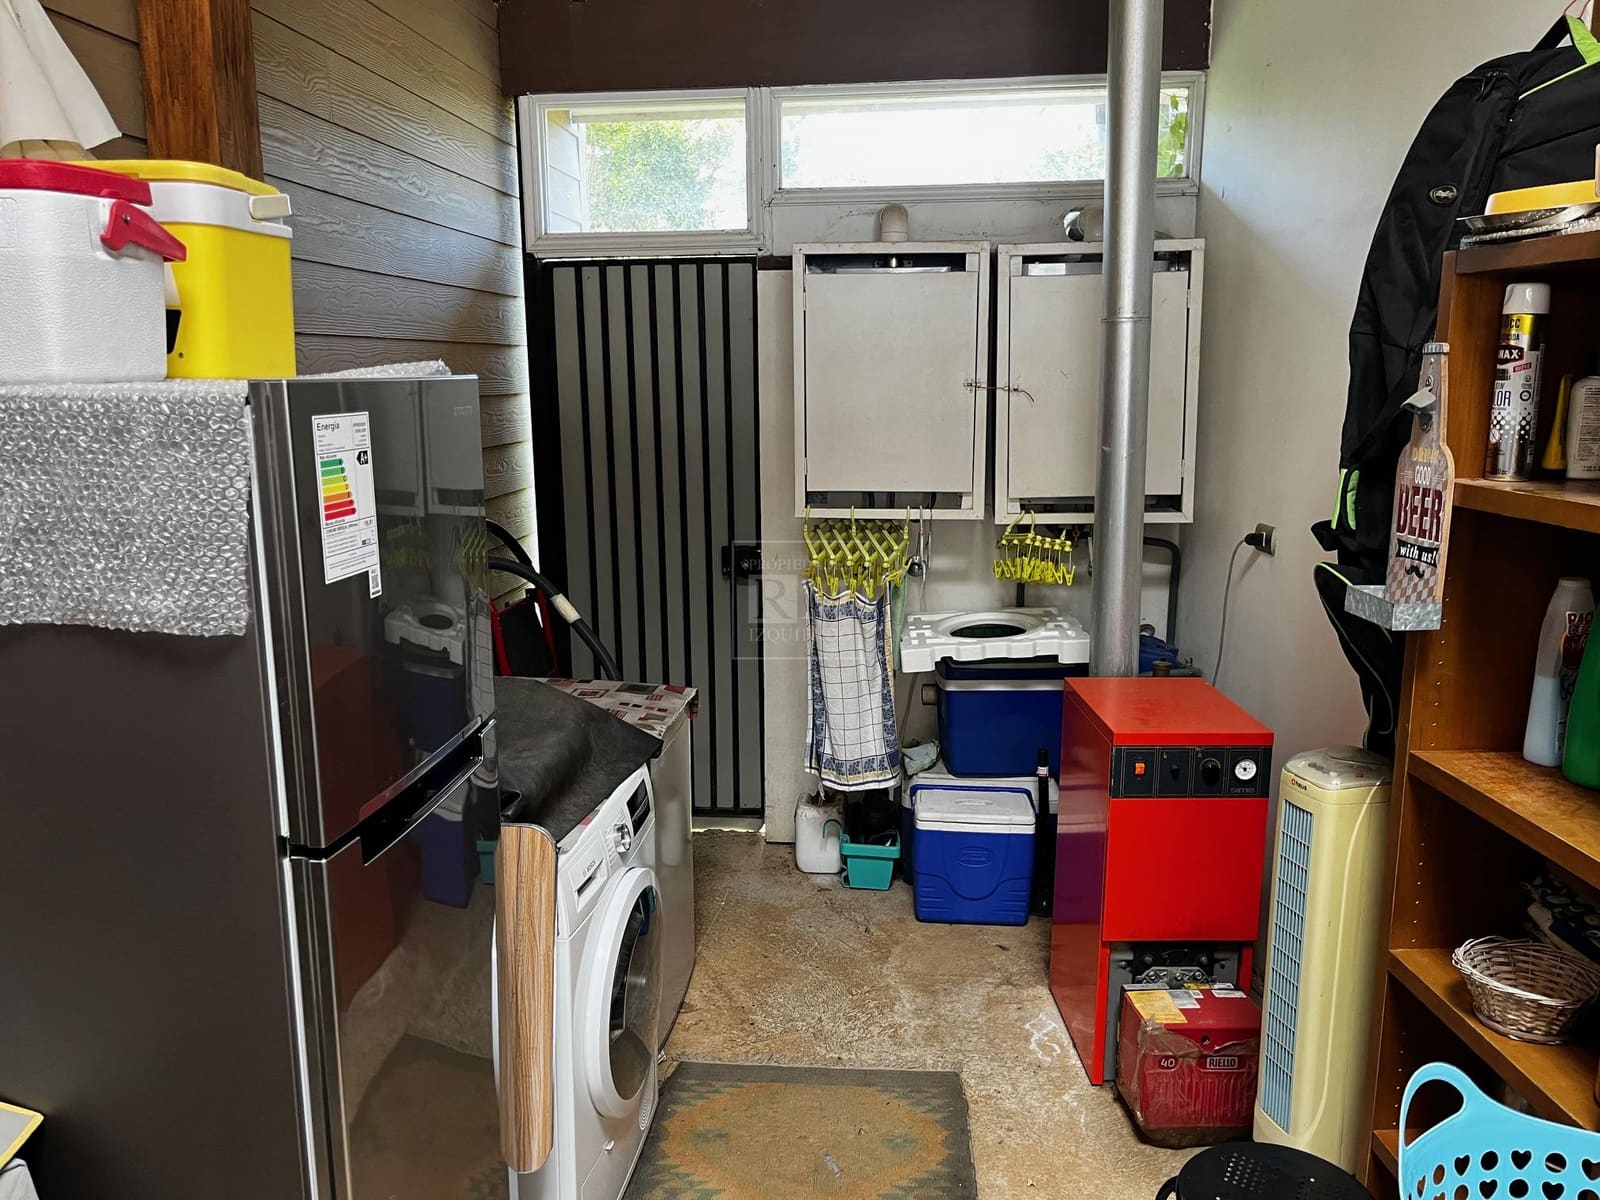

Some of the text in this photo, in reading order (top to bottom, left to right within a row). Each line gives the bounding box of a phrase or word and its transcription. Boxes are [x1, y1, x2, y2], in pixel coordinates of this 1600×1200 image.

[1414, 465, 1431, 485] GOOD
[1396, 483, 1443, 543] BEER
[1399, 544, 1437, 564] with us!
[1160, 1057, 1237, 1068] 40 RIELLO
